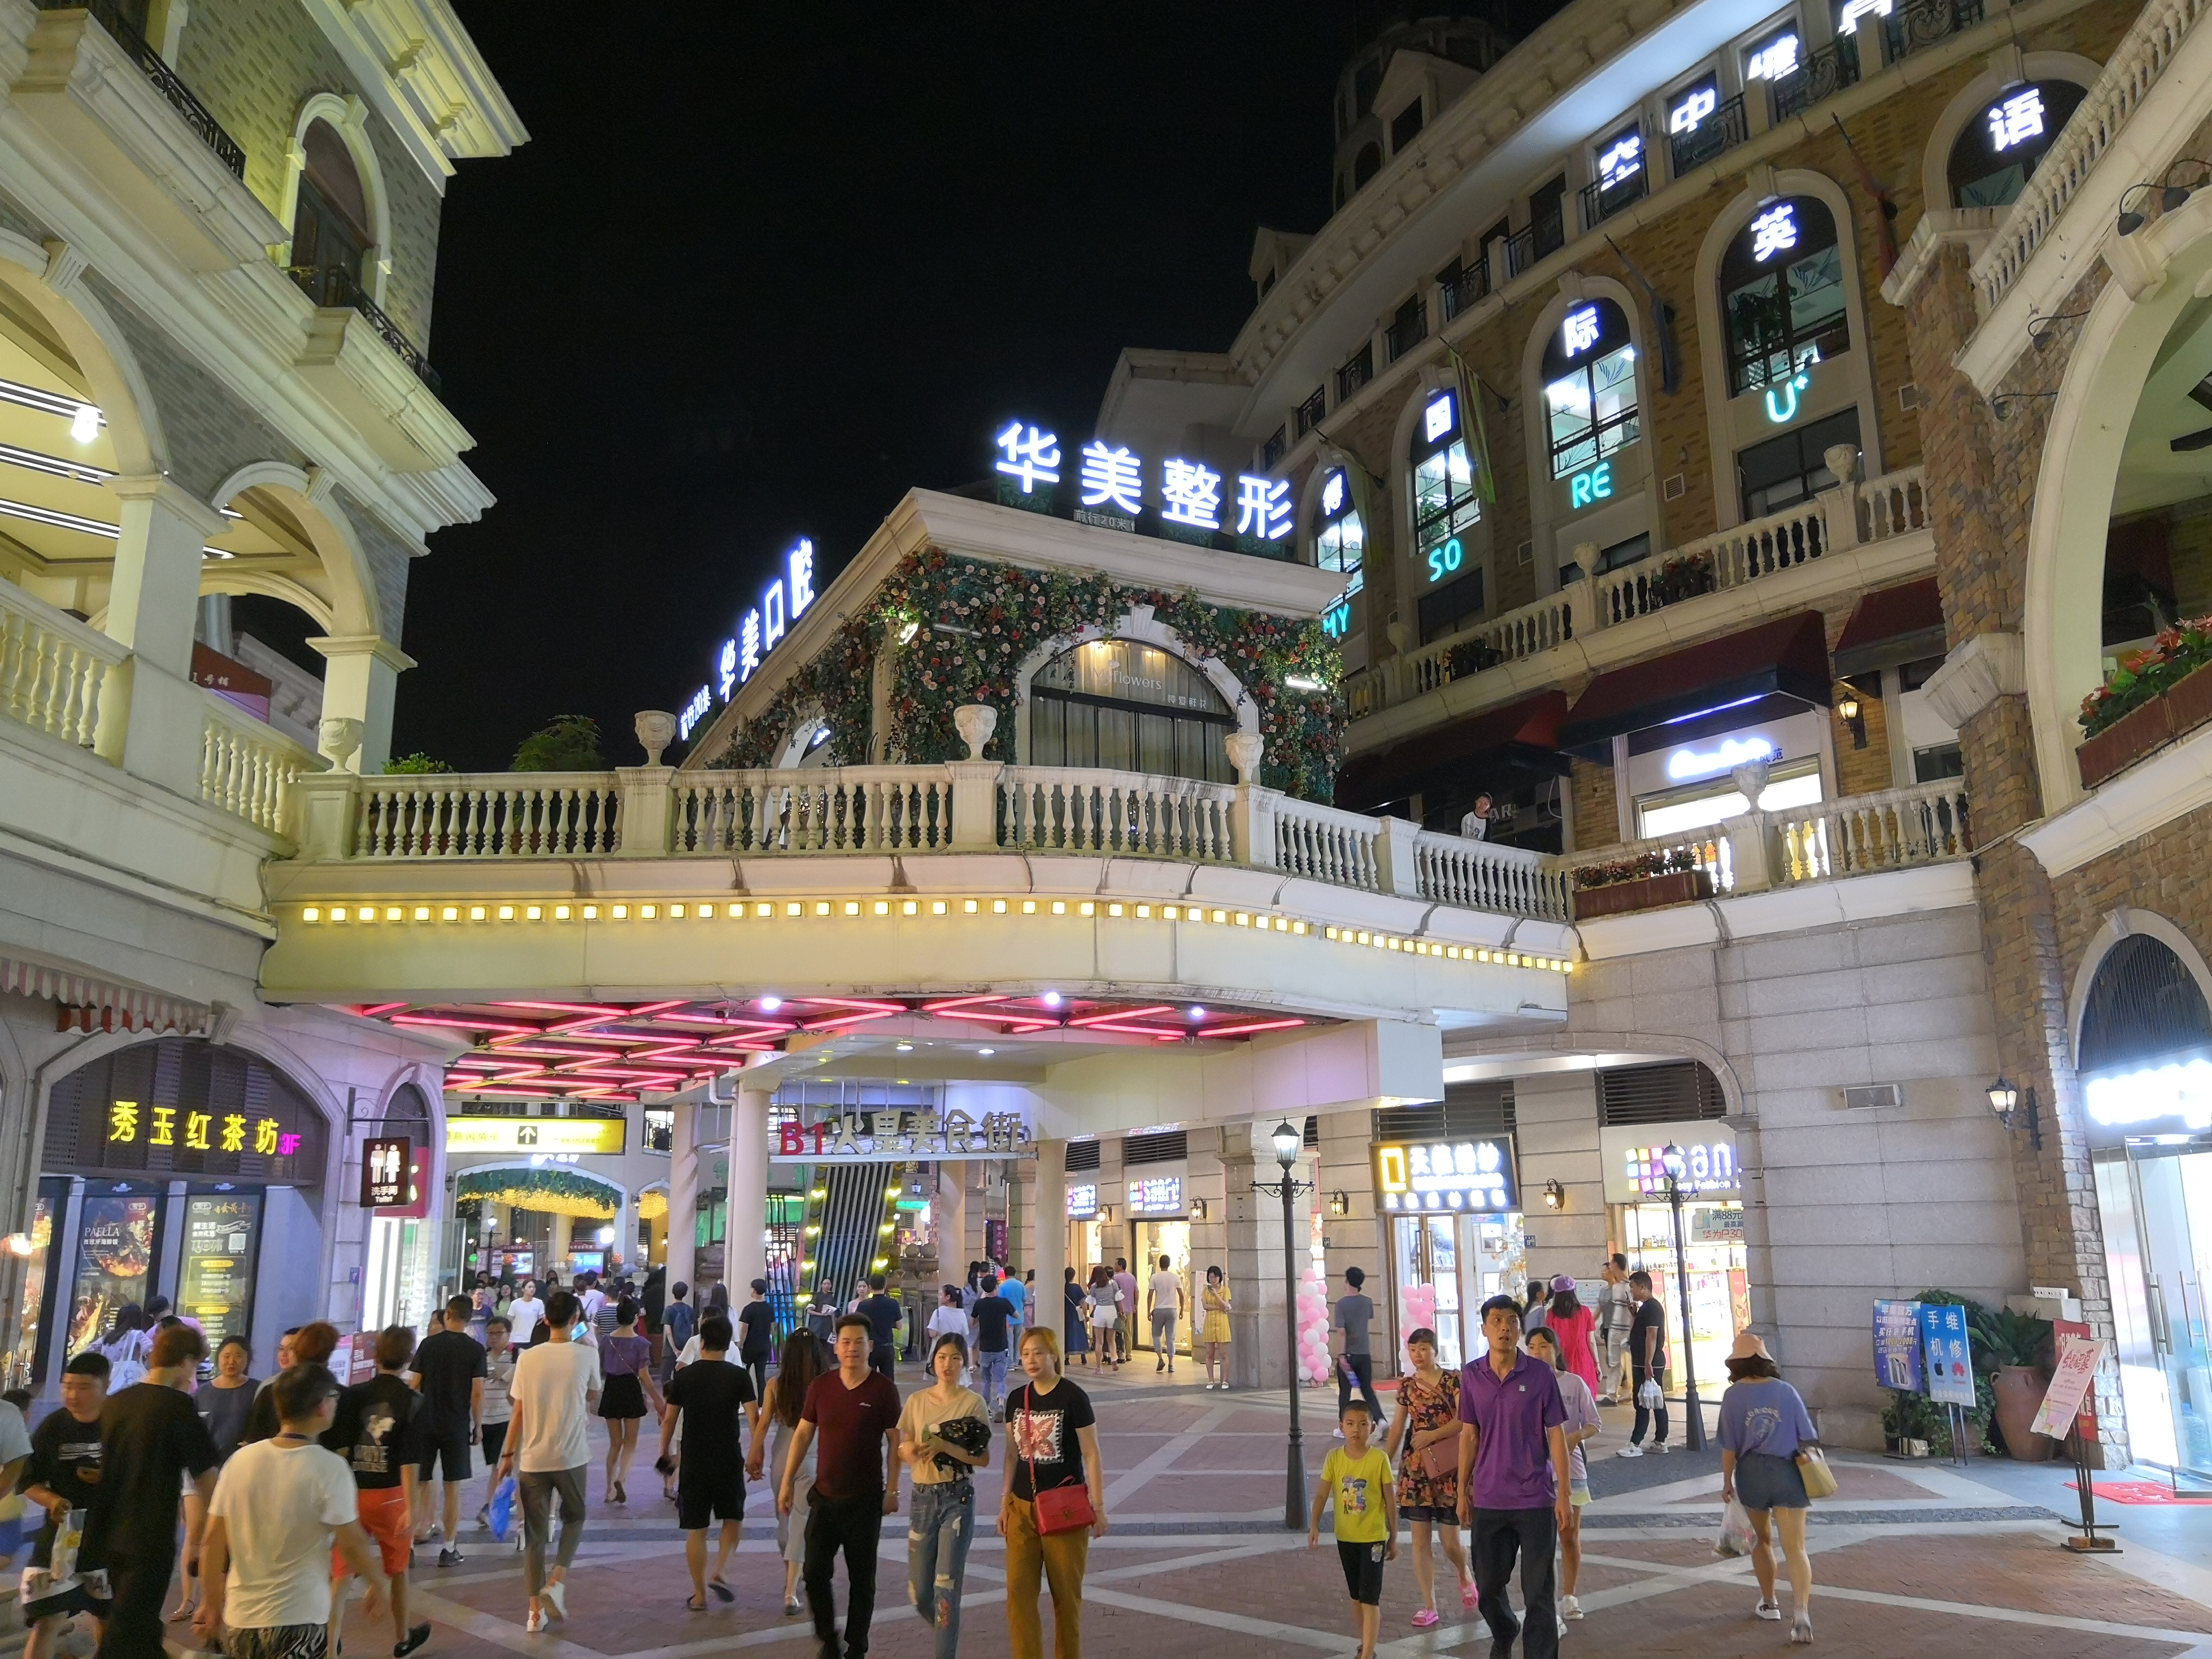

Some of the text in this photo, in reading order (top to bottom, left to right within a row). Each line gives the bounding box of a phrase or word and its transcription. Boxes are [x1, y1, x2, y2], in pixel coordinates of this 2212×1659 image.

[996, 422, 1293, 540] 华美整形
[1428, 539, 1462, 581] SO
[1572, 462, 1611, 509] RE
[109, 1100, 279, 1155] 秀玉红茶坊
[371, 1186, 398, 1196] 洗手间
[84, 1227, 120, 1237] PAELLA
[1702, 1229, 1743, 1239] 华为P30
